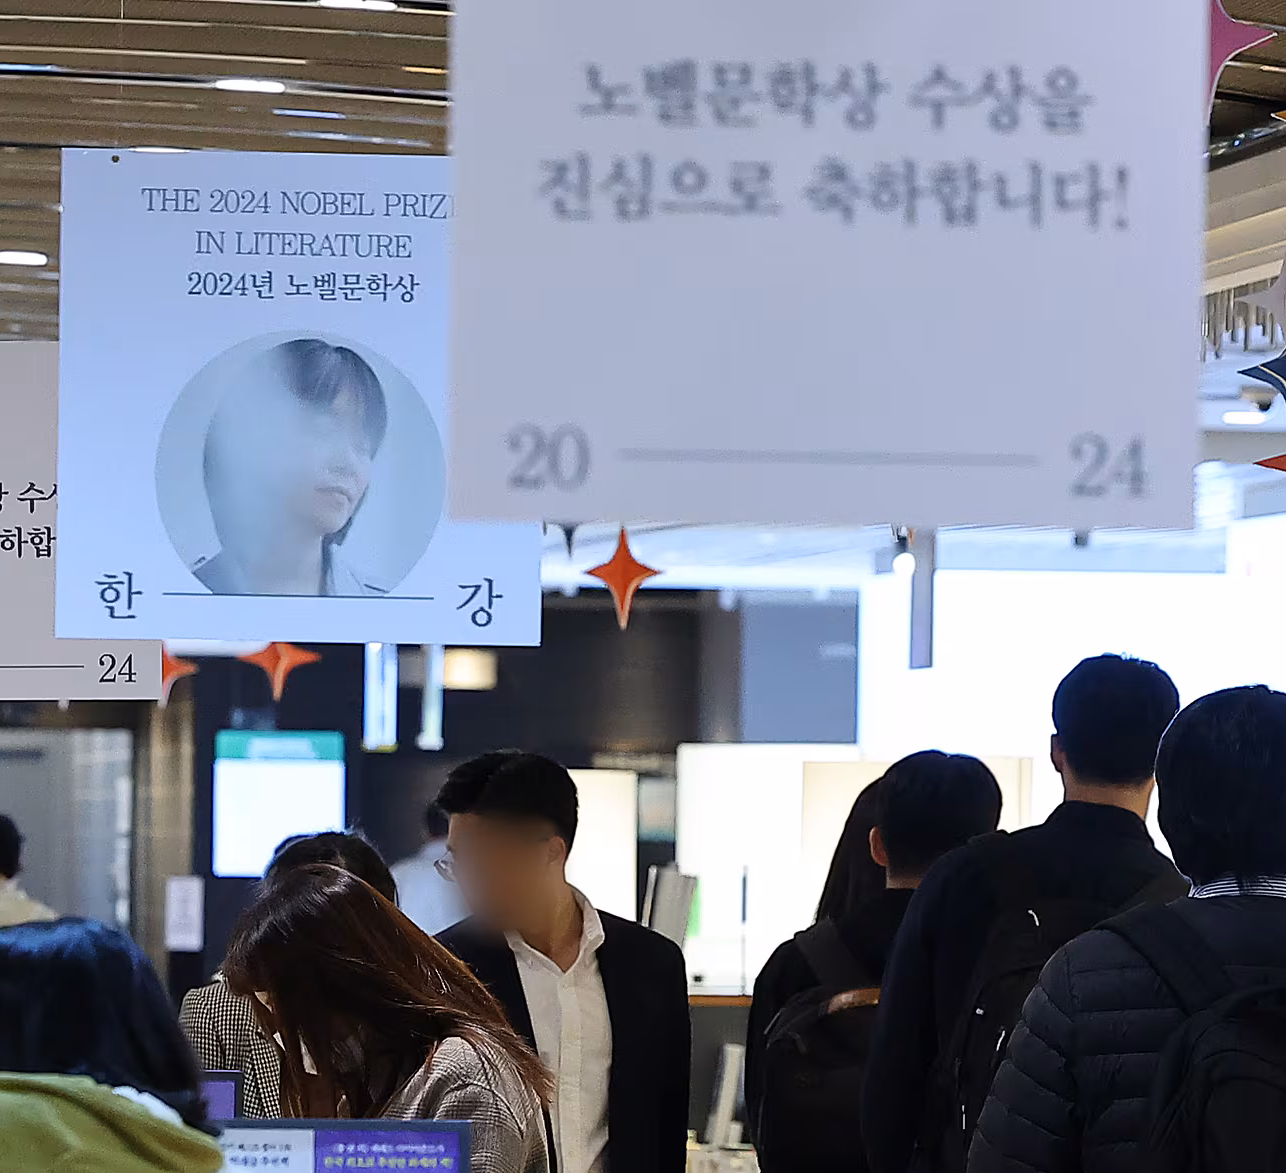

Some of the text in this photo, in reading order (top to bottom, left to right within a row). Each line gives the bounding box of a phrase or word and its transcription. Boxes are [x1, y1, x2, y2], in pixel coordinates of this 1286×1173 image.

[578, 59, 1094, 134] 노벨문학상 수상을
[141, 188, 456, 219] THE 2024 NOBEL PRIZ
[537, 150, 1130, 230] 진심으로 축하합니다!
[196, 231, 412, 259] IN LITERATURE
[187, 271, 420, 303] 2024년 노벨문학상
[506, 423, 1147, 498] 20 24
[95, 571, 503, 627] 한 강
[99, 654, 136, 683] 24
